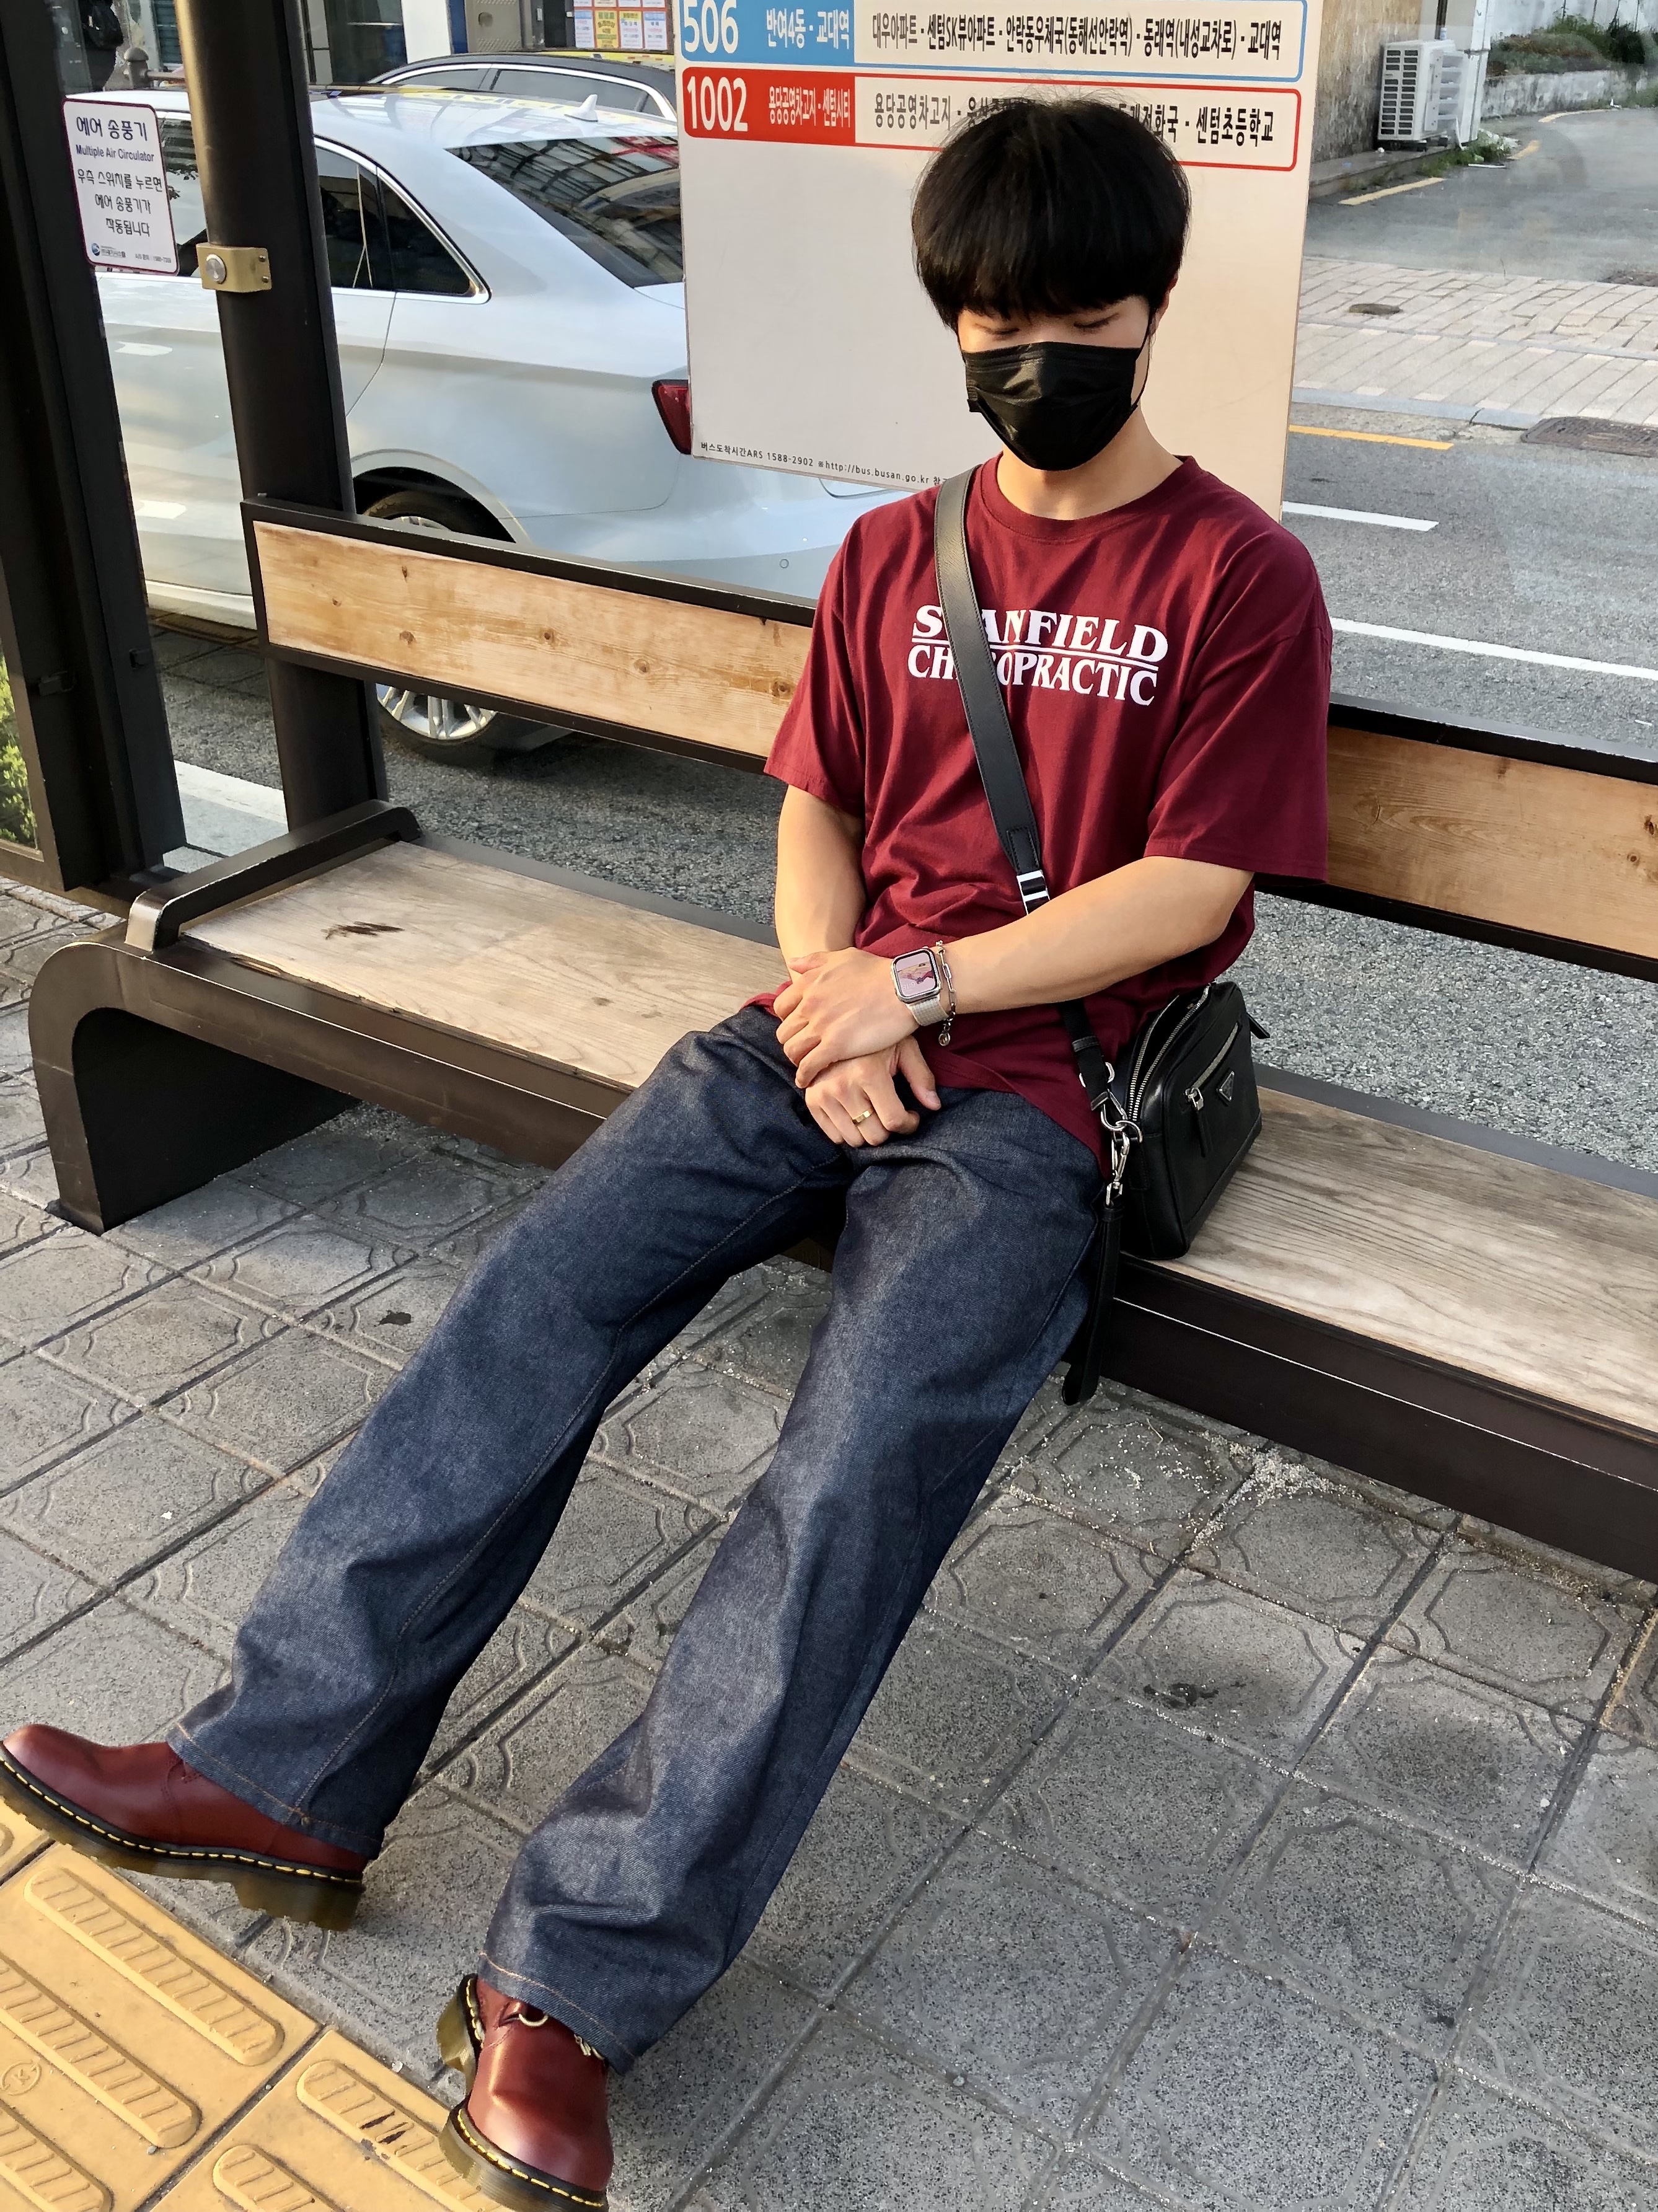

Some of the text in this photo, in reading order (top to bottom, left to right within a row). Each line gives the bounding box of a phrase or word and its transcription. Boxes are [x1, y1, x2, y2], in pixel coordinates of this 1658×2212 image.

[683, 0, 739, 54] 506
[766, 8, 850, 50] 반여4동 교대역
[873, 12, 918, 50] 대우아파트
[927, 14, 996, 51] 센텀SK뷰아파트
[1247, 20, 1282, 61] 교대역
[686, 76, 749, 132] 1002
[768, 86, 851, 128] 용당공영차고지 센텀시티
[874, 92, 951, 131] 용당공영차고지
[1119, 103, 1179, 143] 전화국
[1195, 105, 1274, 148] 센텀초등학교
[76, 116, 148, 142] 에어 송풍기
[76, 144, 154, 162] Multiple Air Circulator
[77, 168, 163, 193] 우측 스위치를 누르면
[94, 193, 151, 215] 에어 송풍기가
[105, 217, 150, 237] 작동됩니다
[700, 441, 764, 459] 버스도착시간ARS
[767, 451, 814, 467] 1588-2902
[912, 604, 1168, 663] SANFIELD
[907, 645, 1158, 707] CHOPRACTIC
